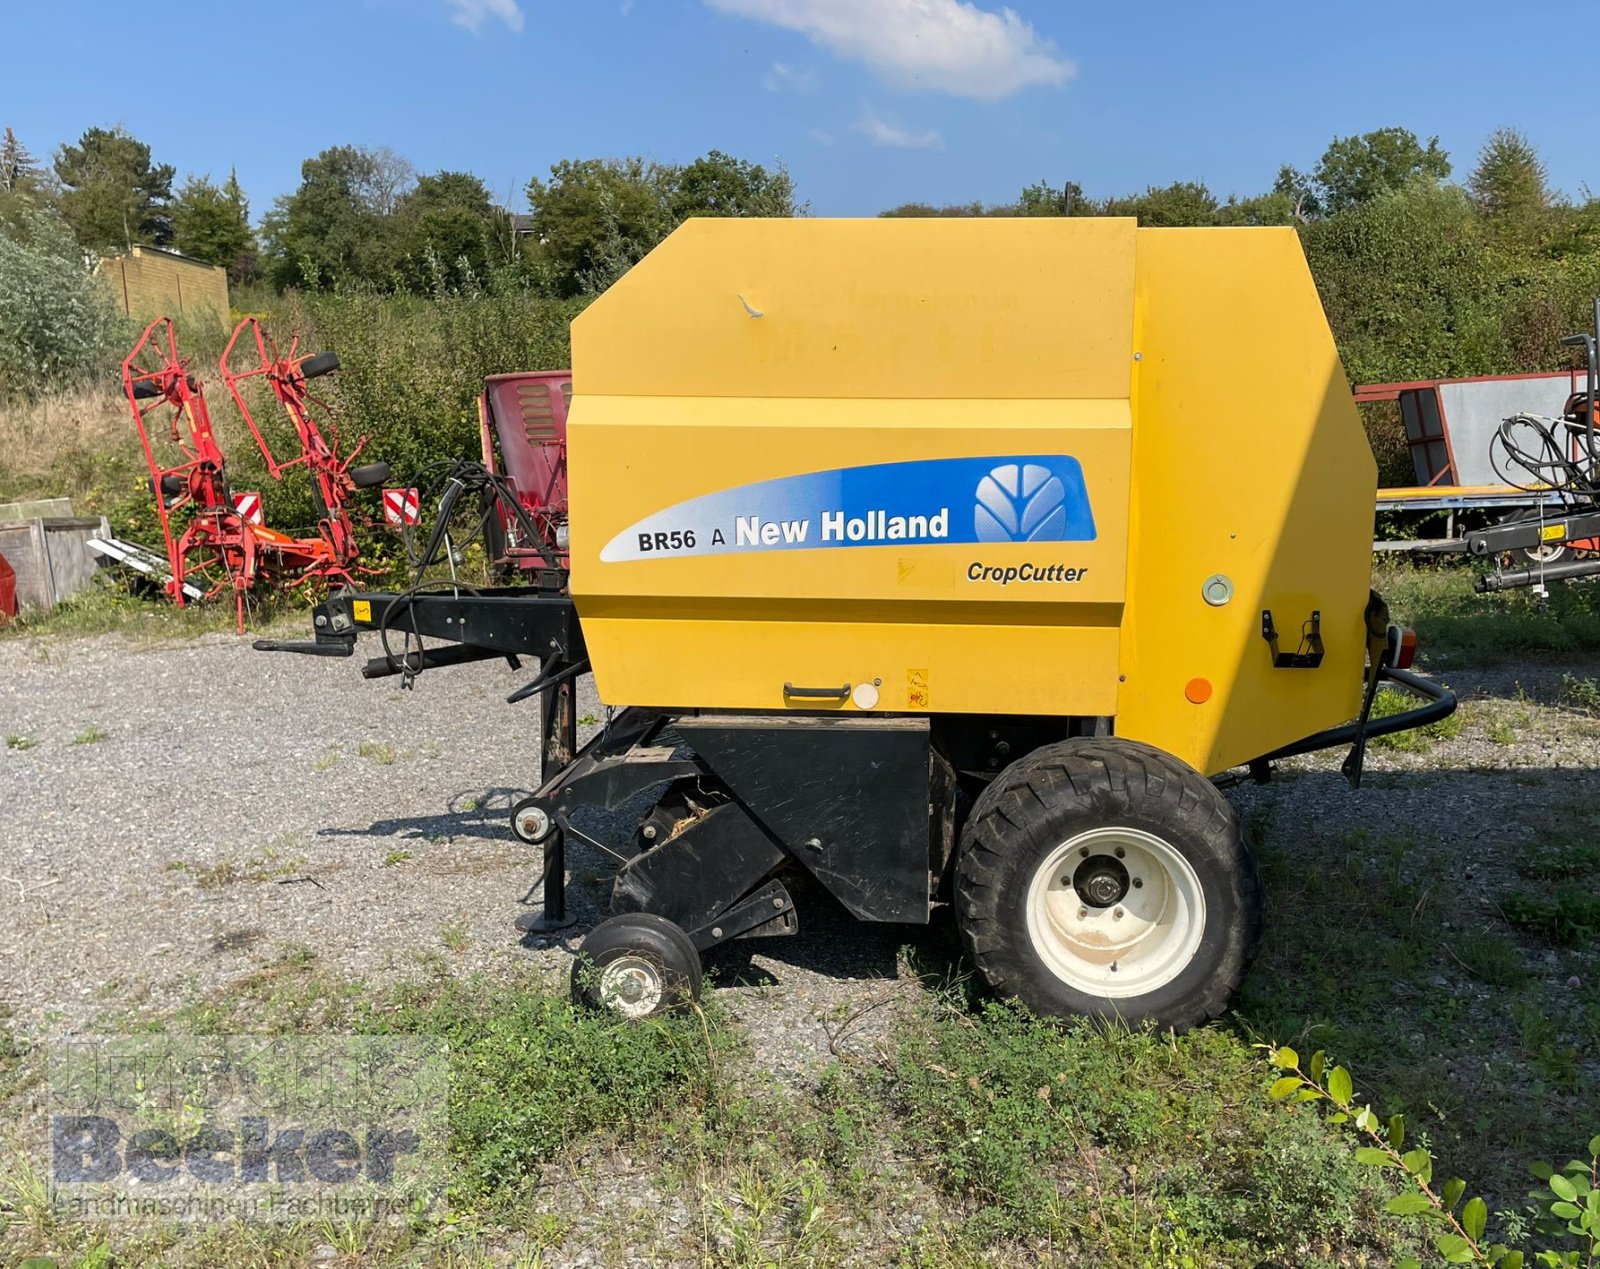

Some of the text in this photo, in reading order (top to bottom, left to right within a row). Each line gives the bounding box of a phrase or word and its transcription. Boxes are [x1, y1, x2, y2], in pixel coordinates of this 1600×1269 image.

[638, 507, 949, 552] BR56 A New Holland
[967, 562, 1089, 586] CropCutter
